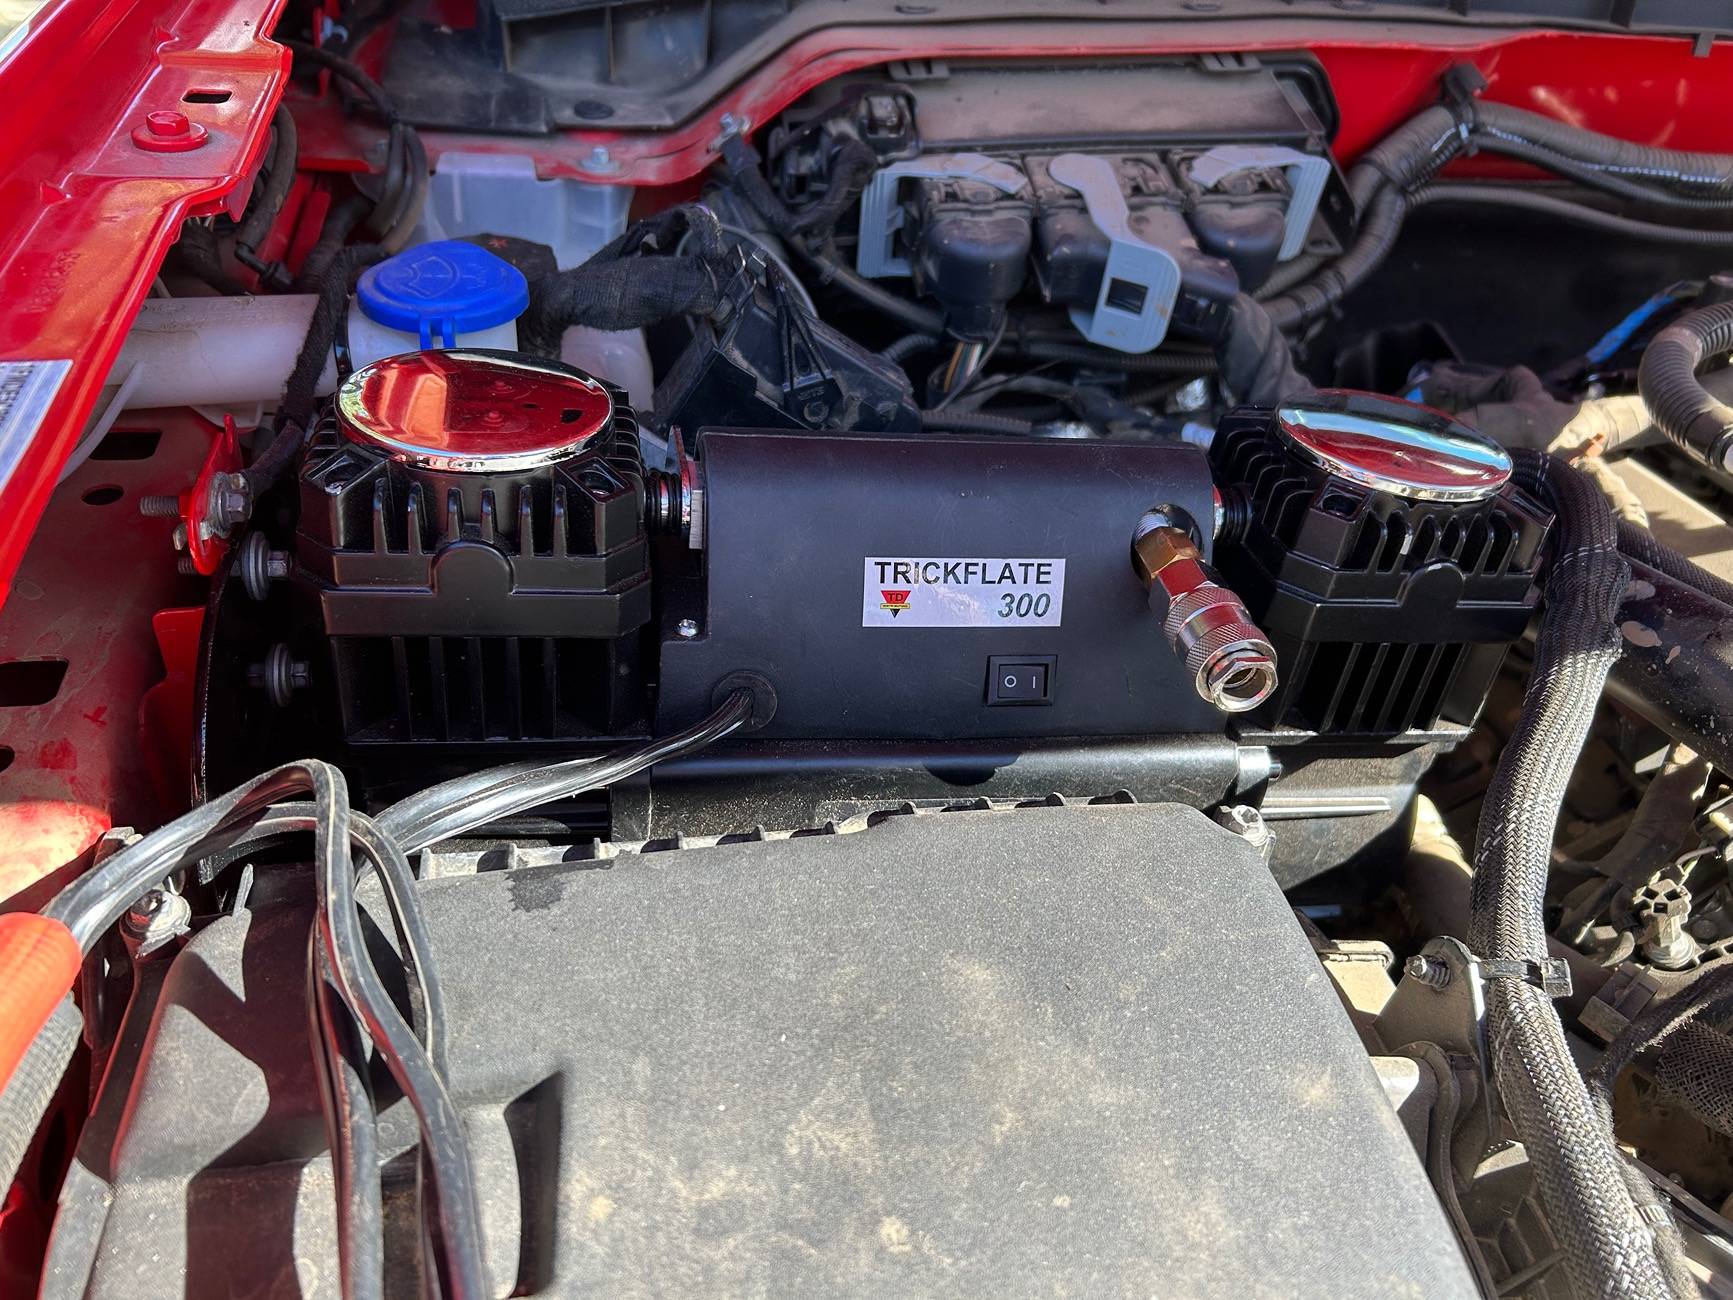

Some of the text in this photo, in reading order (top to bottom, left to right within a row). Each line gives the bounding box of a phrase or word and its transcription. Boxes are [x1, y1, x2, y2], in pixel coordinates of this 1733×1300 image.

[874, 561, 1053, 584] TRICKFLATE
[887, 592, 904, 602] TD
[997, 592, 1051, 618] 300
